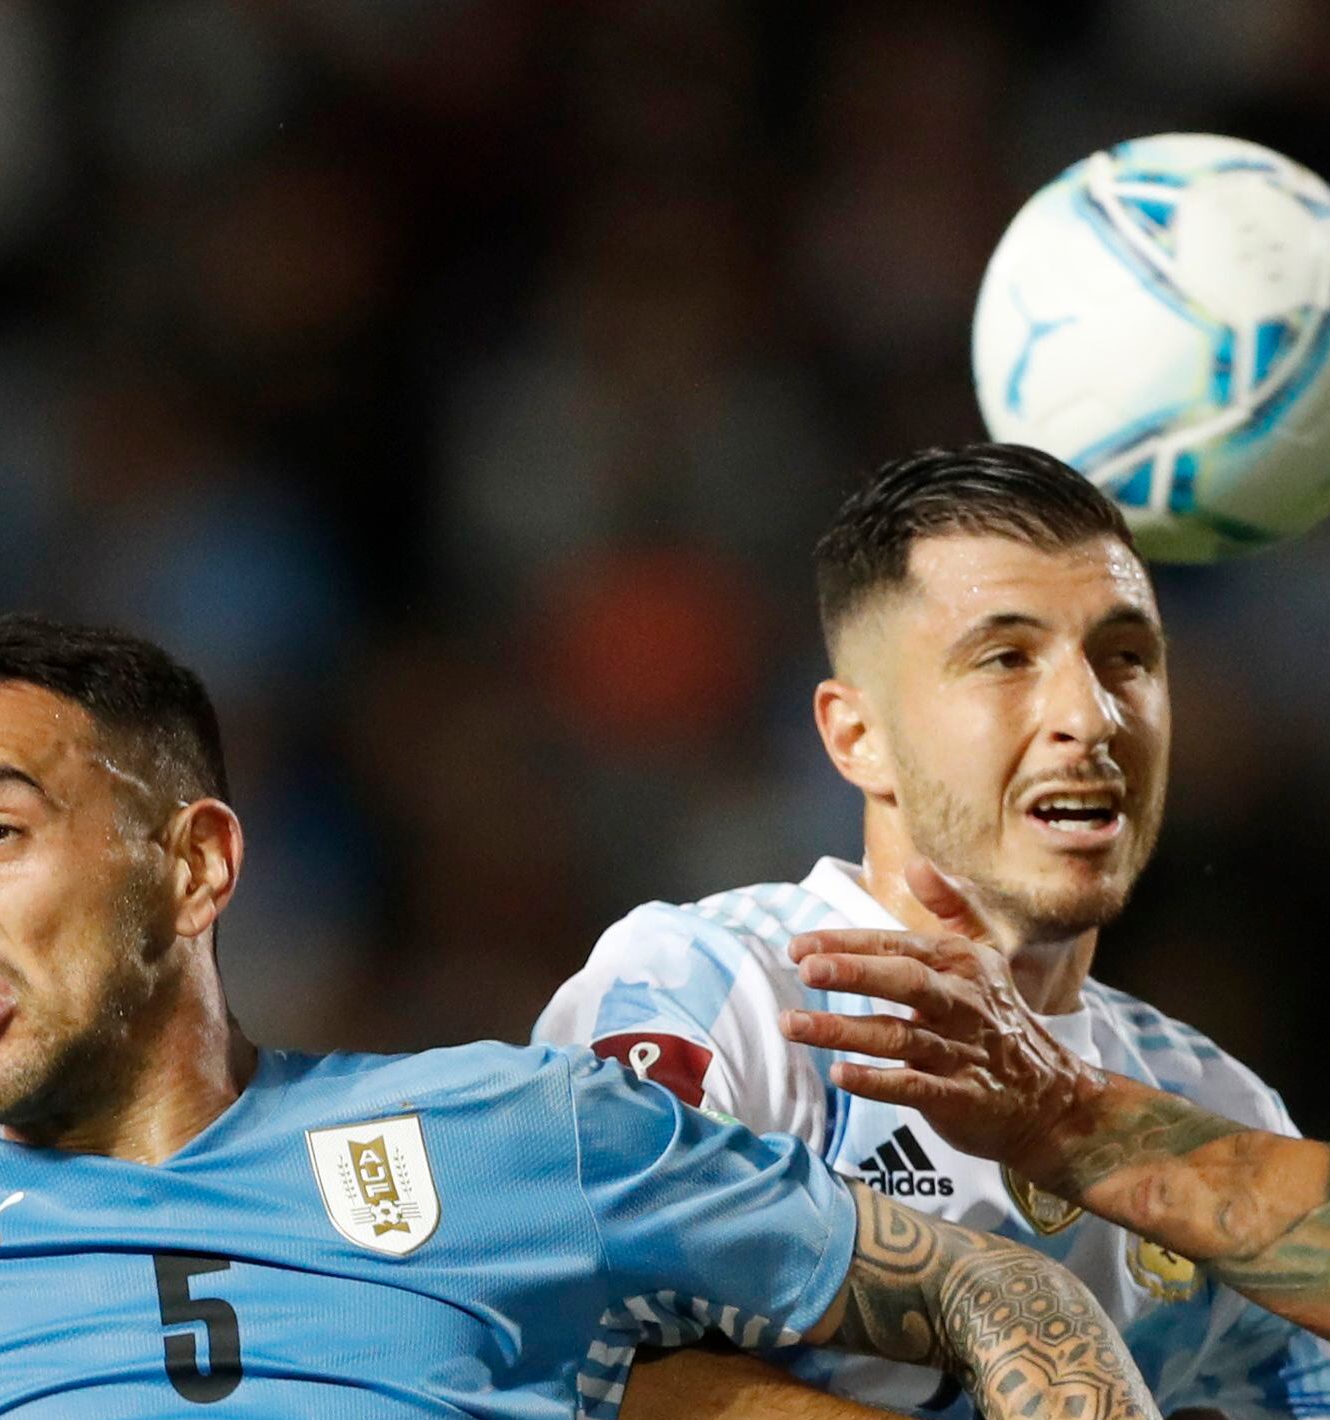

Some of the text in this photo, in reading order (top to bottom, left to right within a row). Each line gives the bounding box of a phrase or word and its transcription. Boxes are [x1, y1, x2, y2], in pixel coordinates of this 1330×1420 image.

[358, 1148, 392, 1199] AUF
[857, 1171, 954, 1196] didas
[152, 1253, 245, 1405] 5
